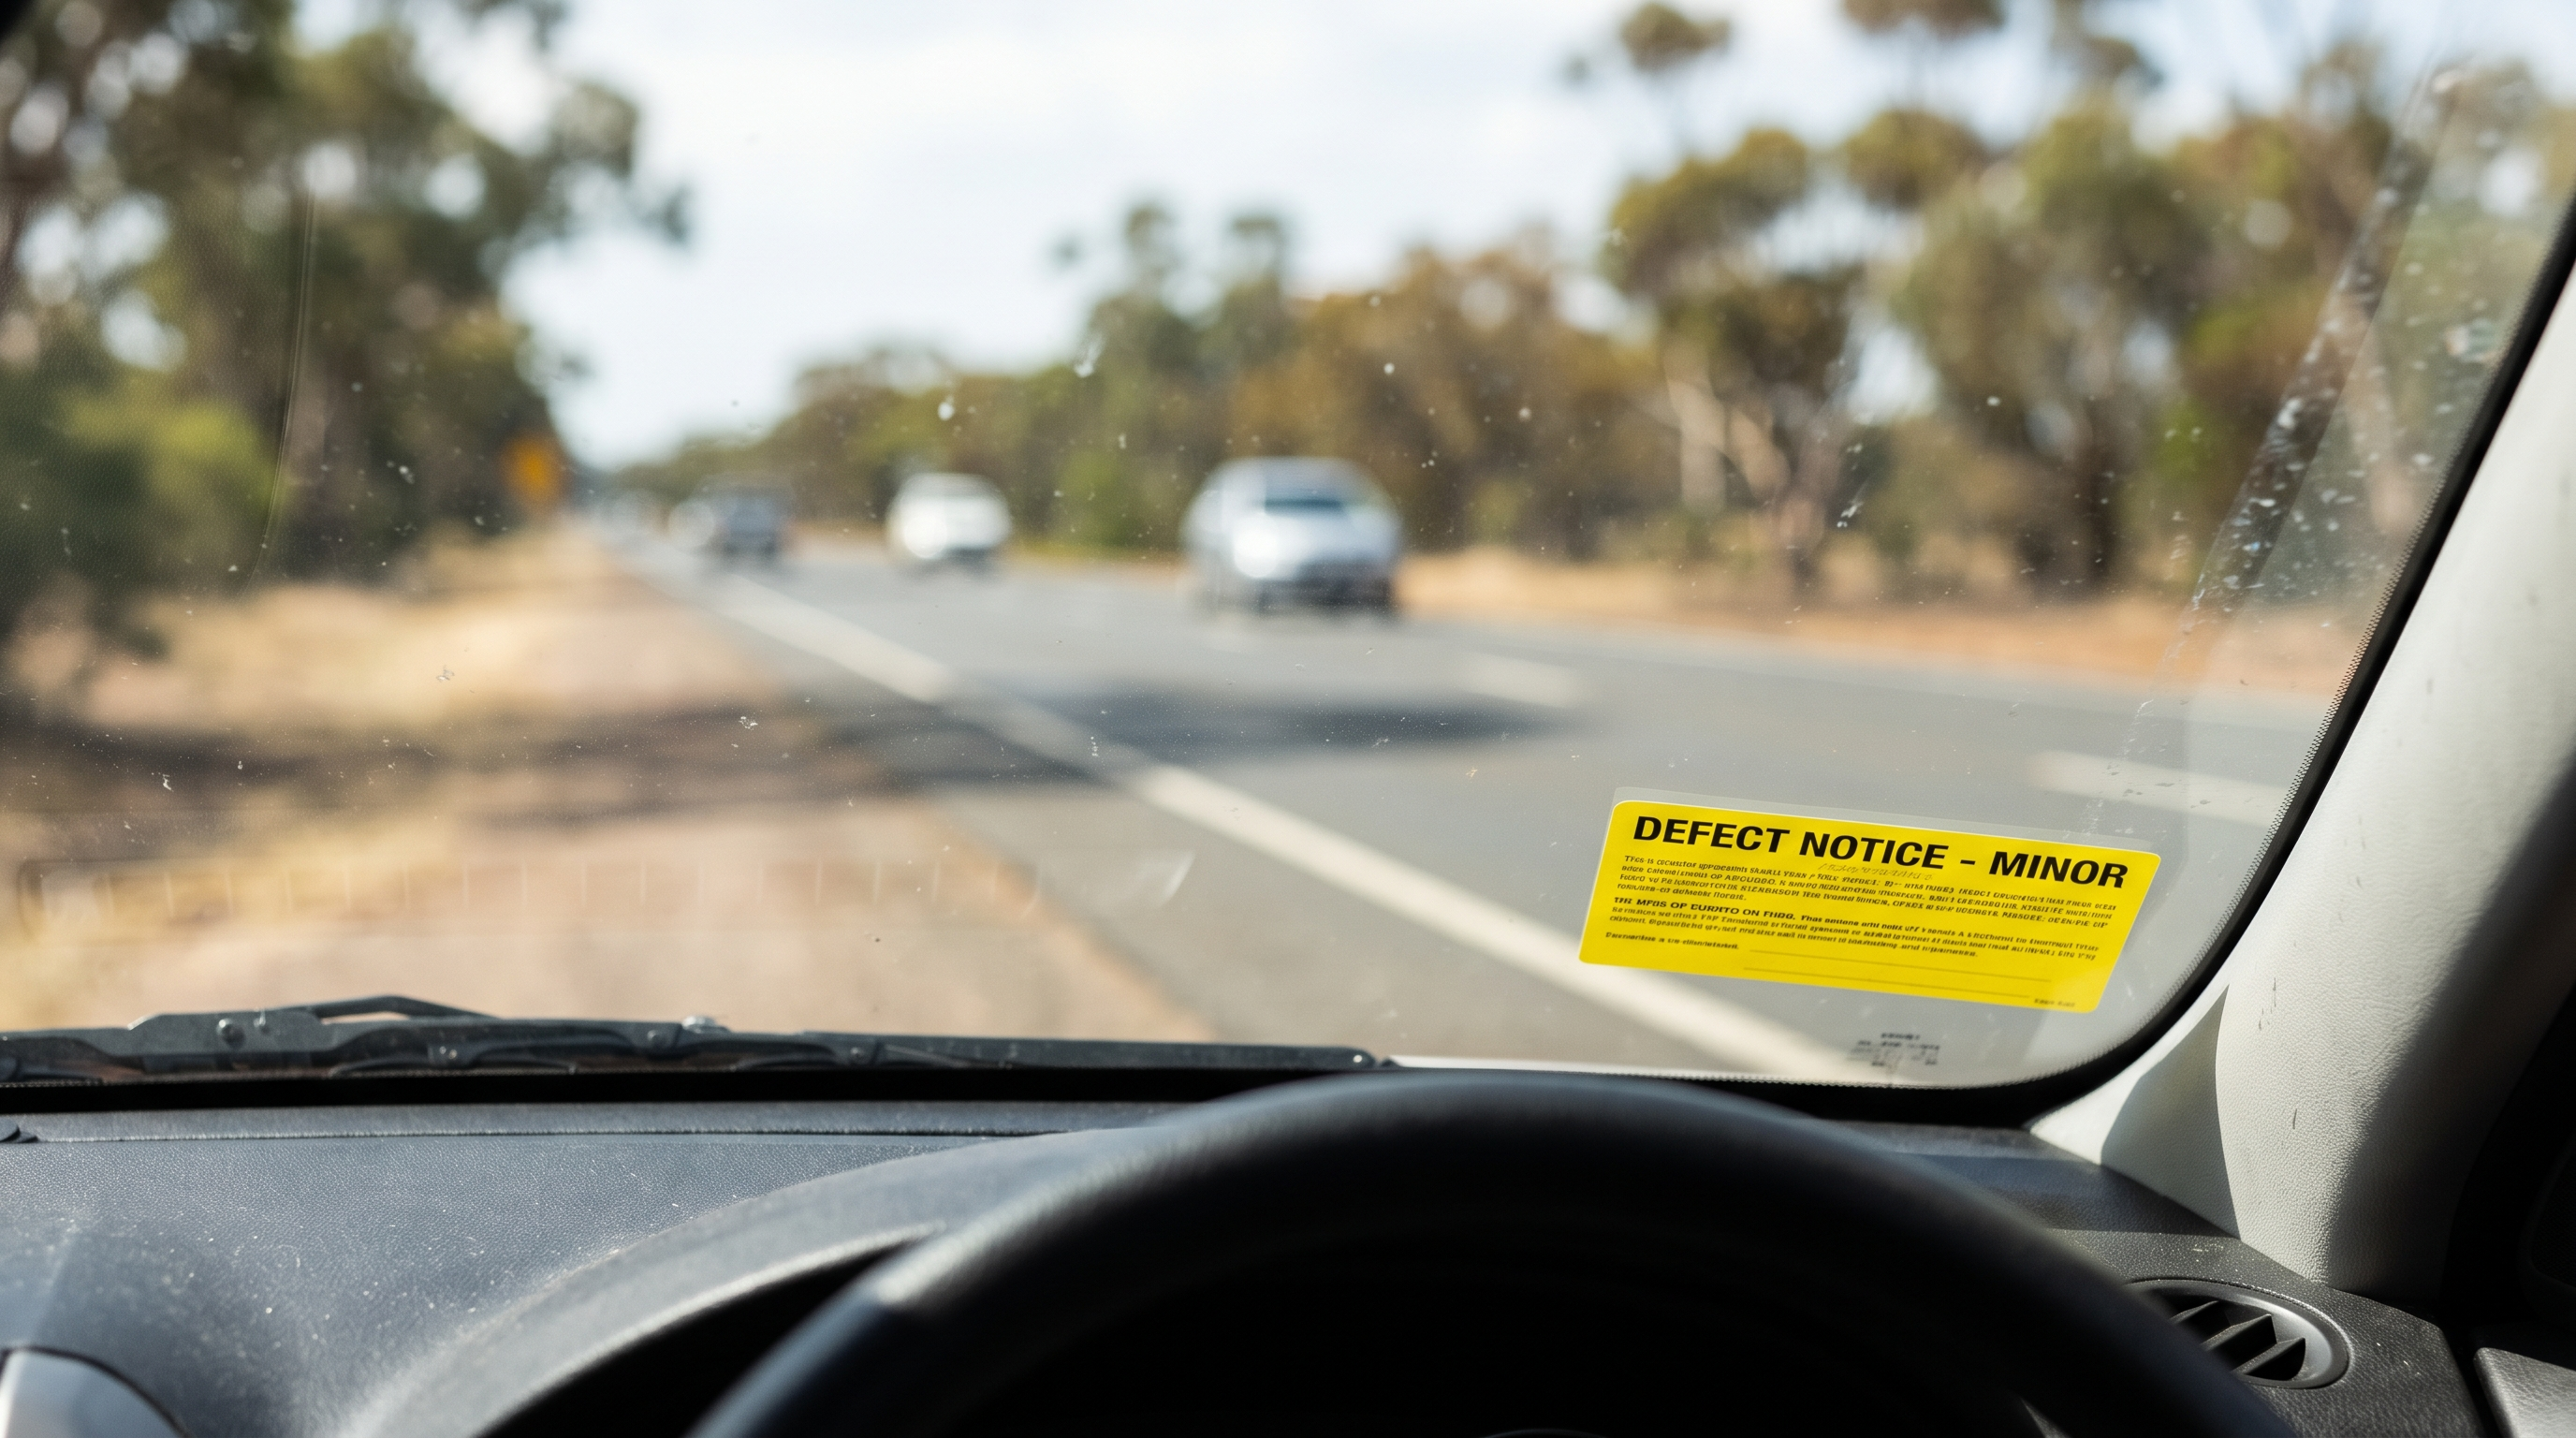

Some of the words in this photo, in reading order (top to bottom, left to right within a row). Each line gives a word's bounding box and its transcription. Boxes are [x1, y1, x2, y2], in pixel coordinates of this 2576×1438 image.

[1633, 815, 1791, 853] DEFECT
[1799, 831, 1949, 870] NOTICE
[1988, 851, 2129, 888] MINOR
